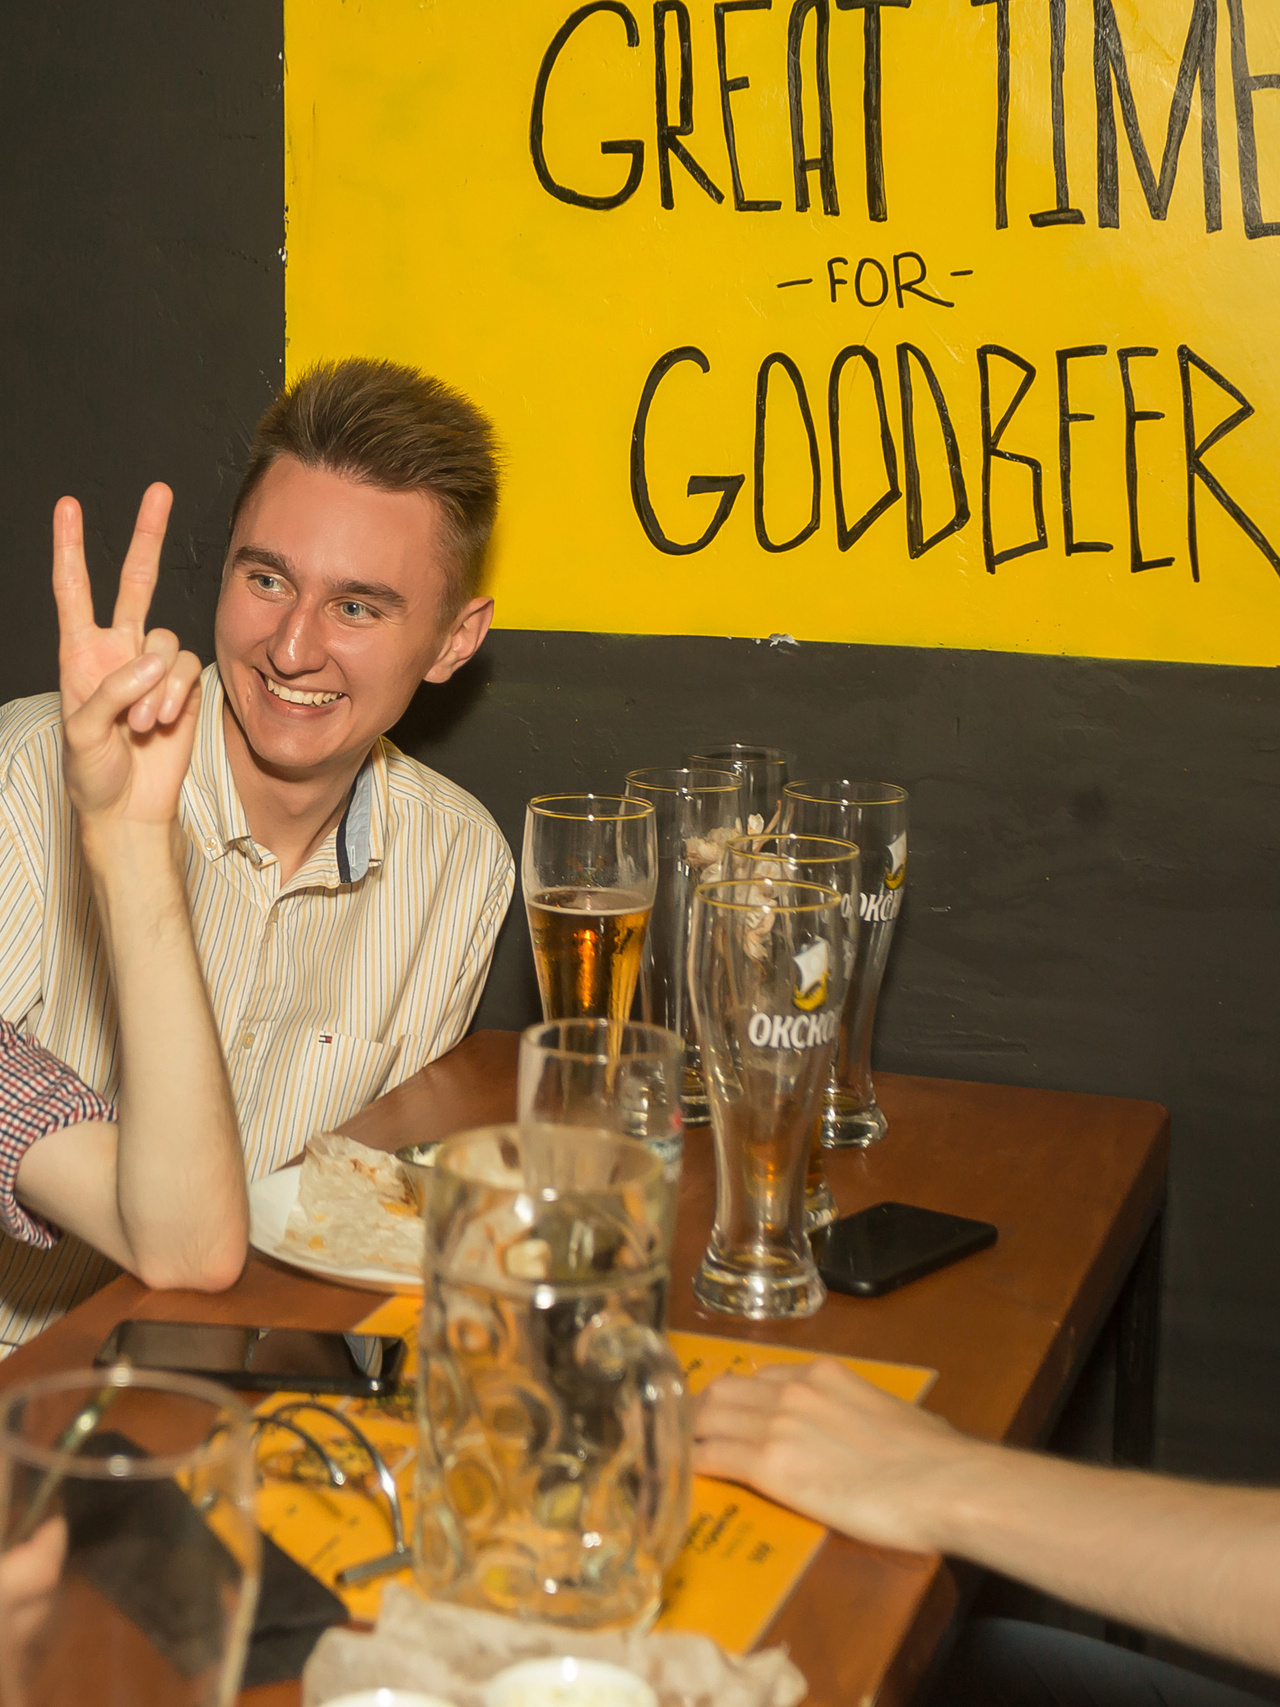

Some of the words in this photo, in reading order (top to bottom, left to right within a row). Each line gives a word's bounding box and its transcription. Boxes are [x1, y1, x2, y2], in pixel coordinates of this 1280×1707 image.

[530, 0, 911, 223] GREAT
[971, 0, 1280, 240] TIME
[630, 342, 1280, 582] GOODBEER
